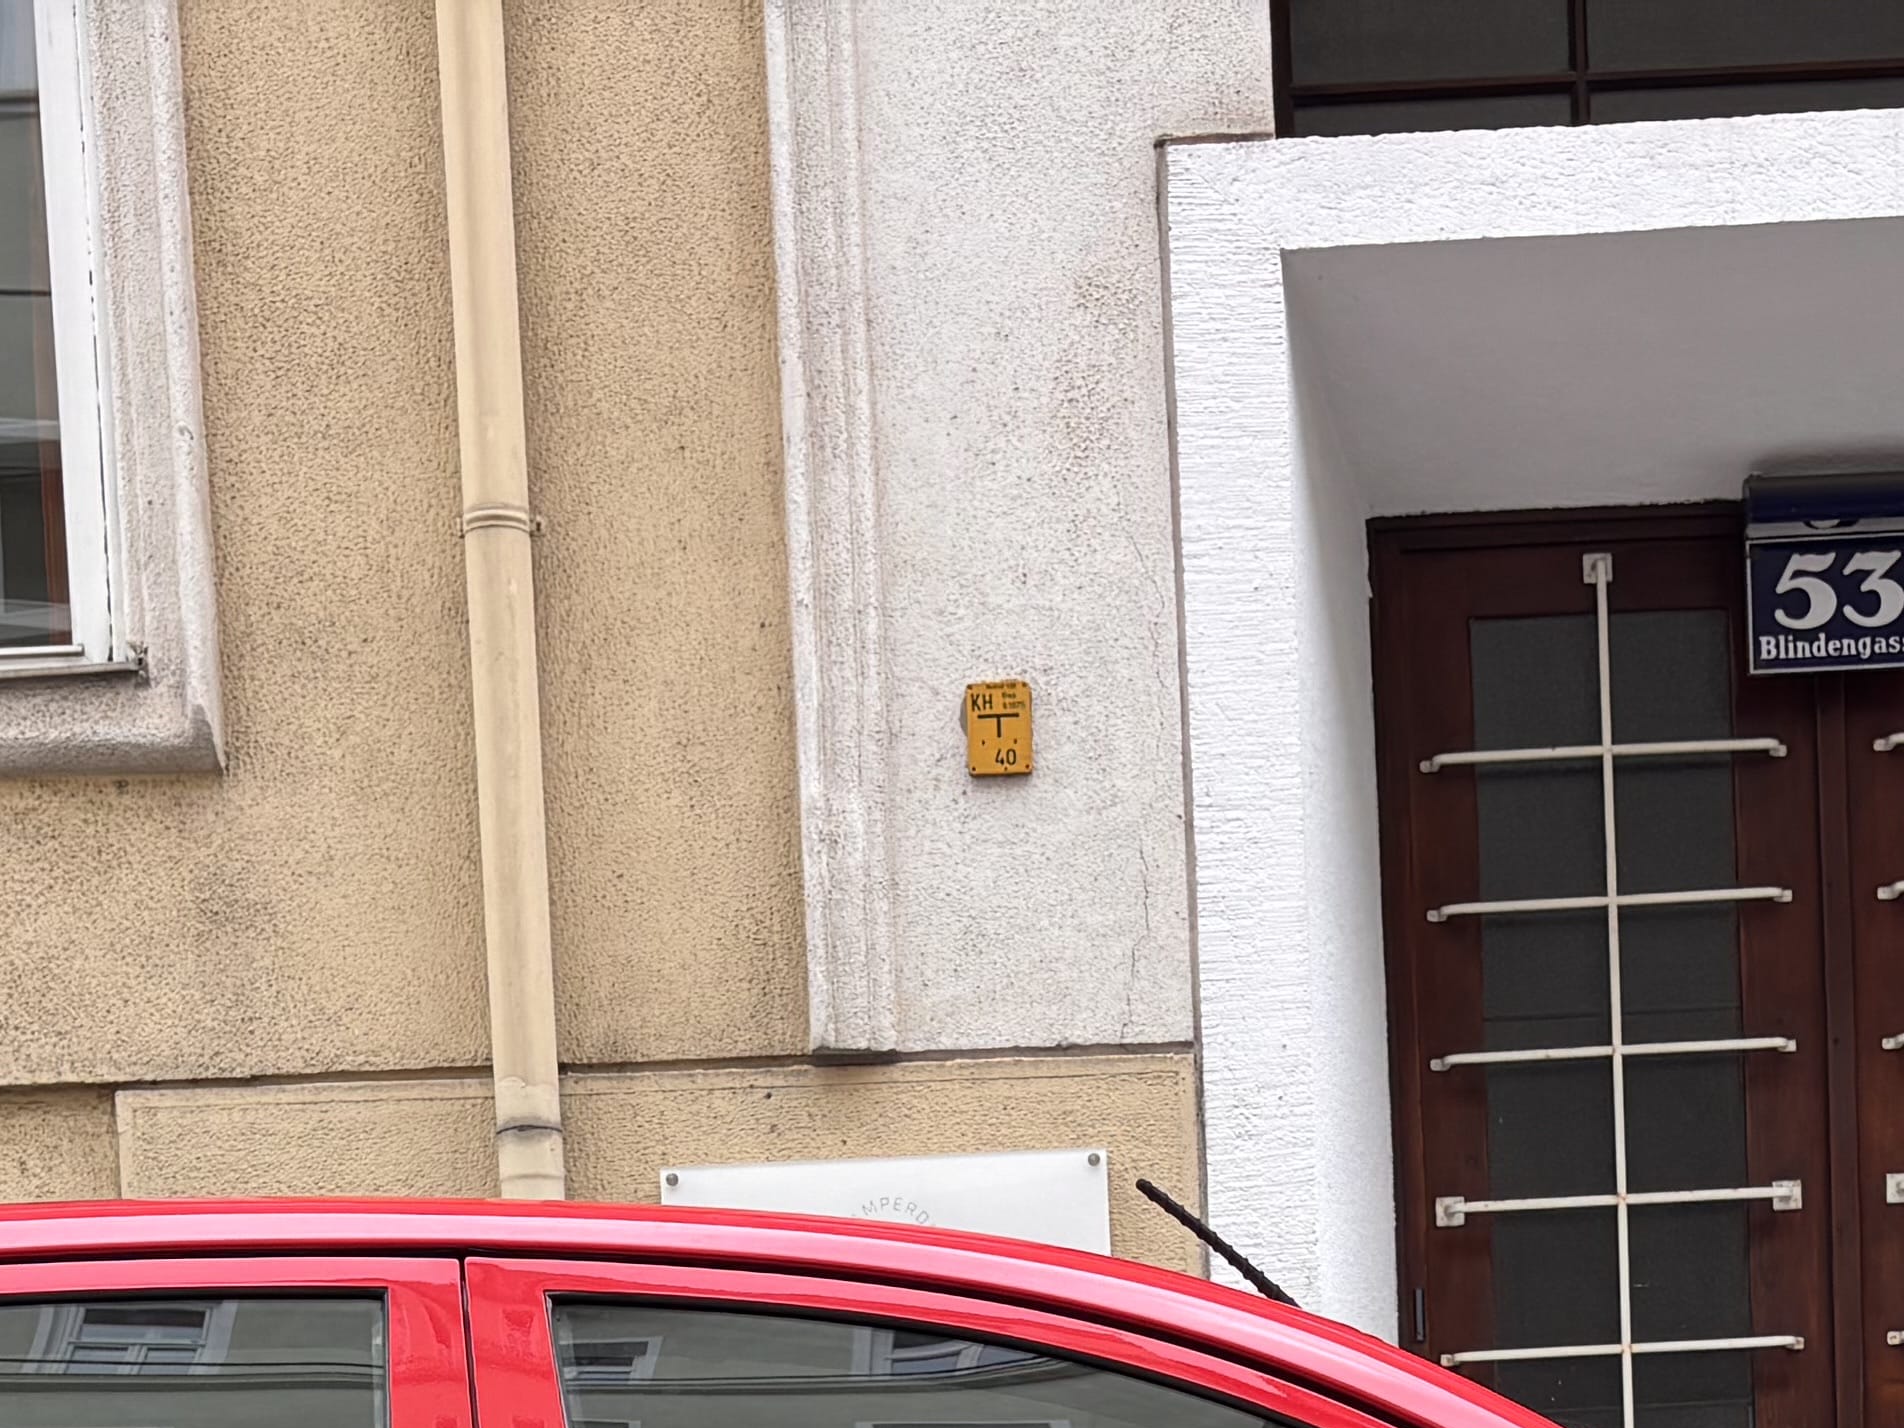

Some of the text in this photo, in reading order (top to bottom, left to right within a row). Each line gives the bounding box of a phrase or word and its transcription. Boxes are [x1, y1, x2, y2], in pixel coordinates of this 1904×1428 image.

[970, 693, 993, 712] KH
[994, 748, 1017, 766] 40
[860, 1196, 933, 1226] MPERD
